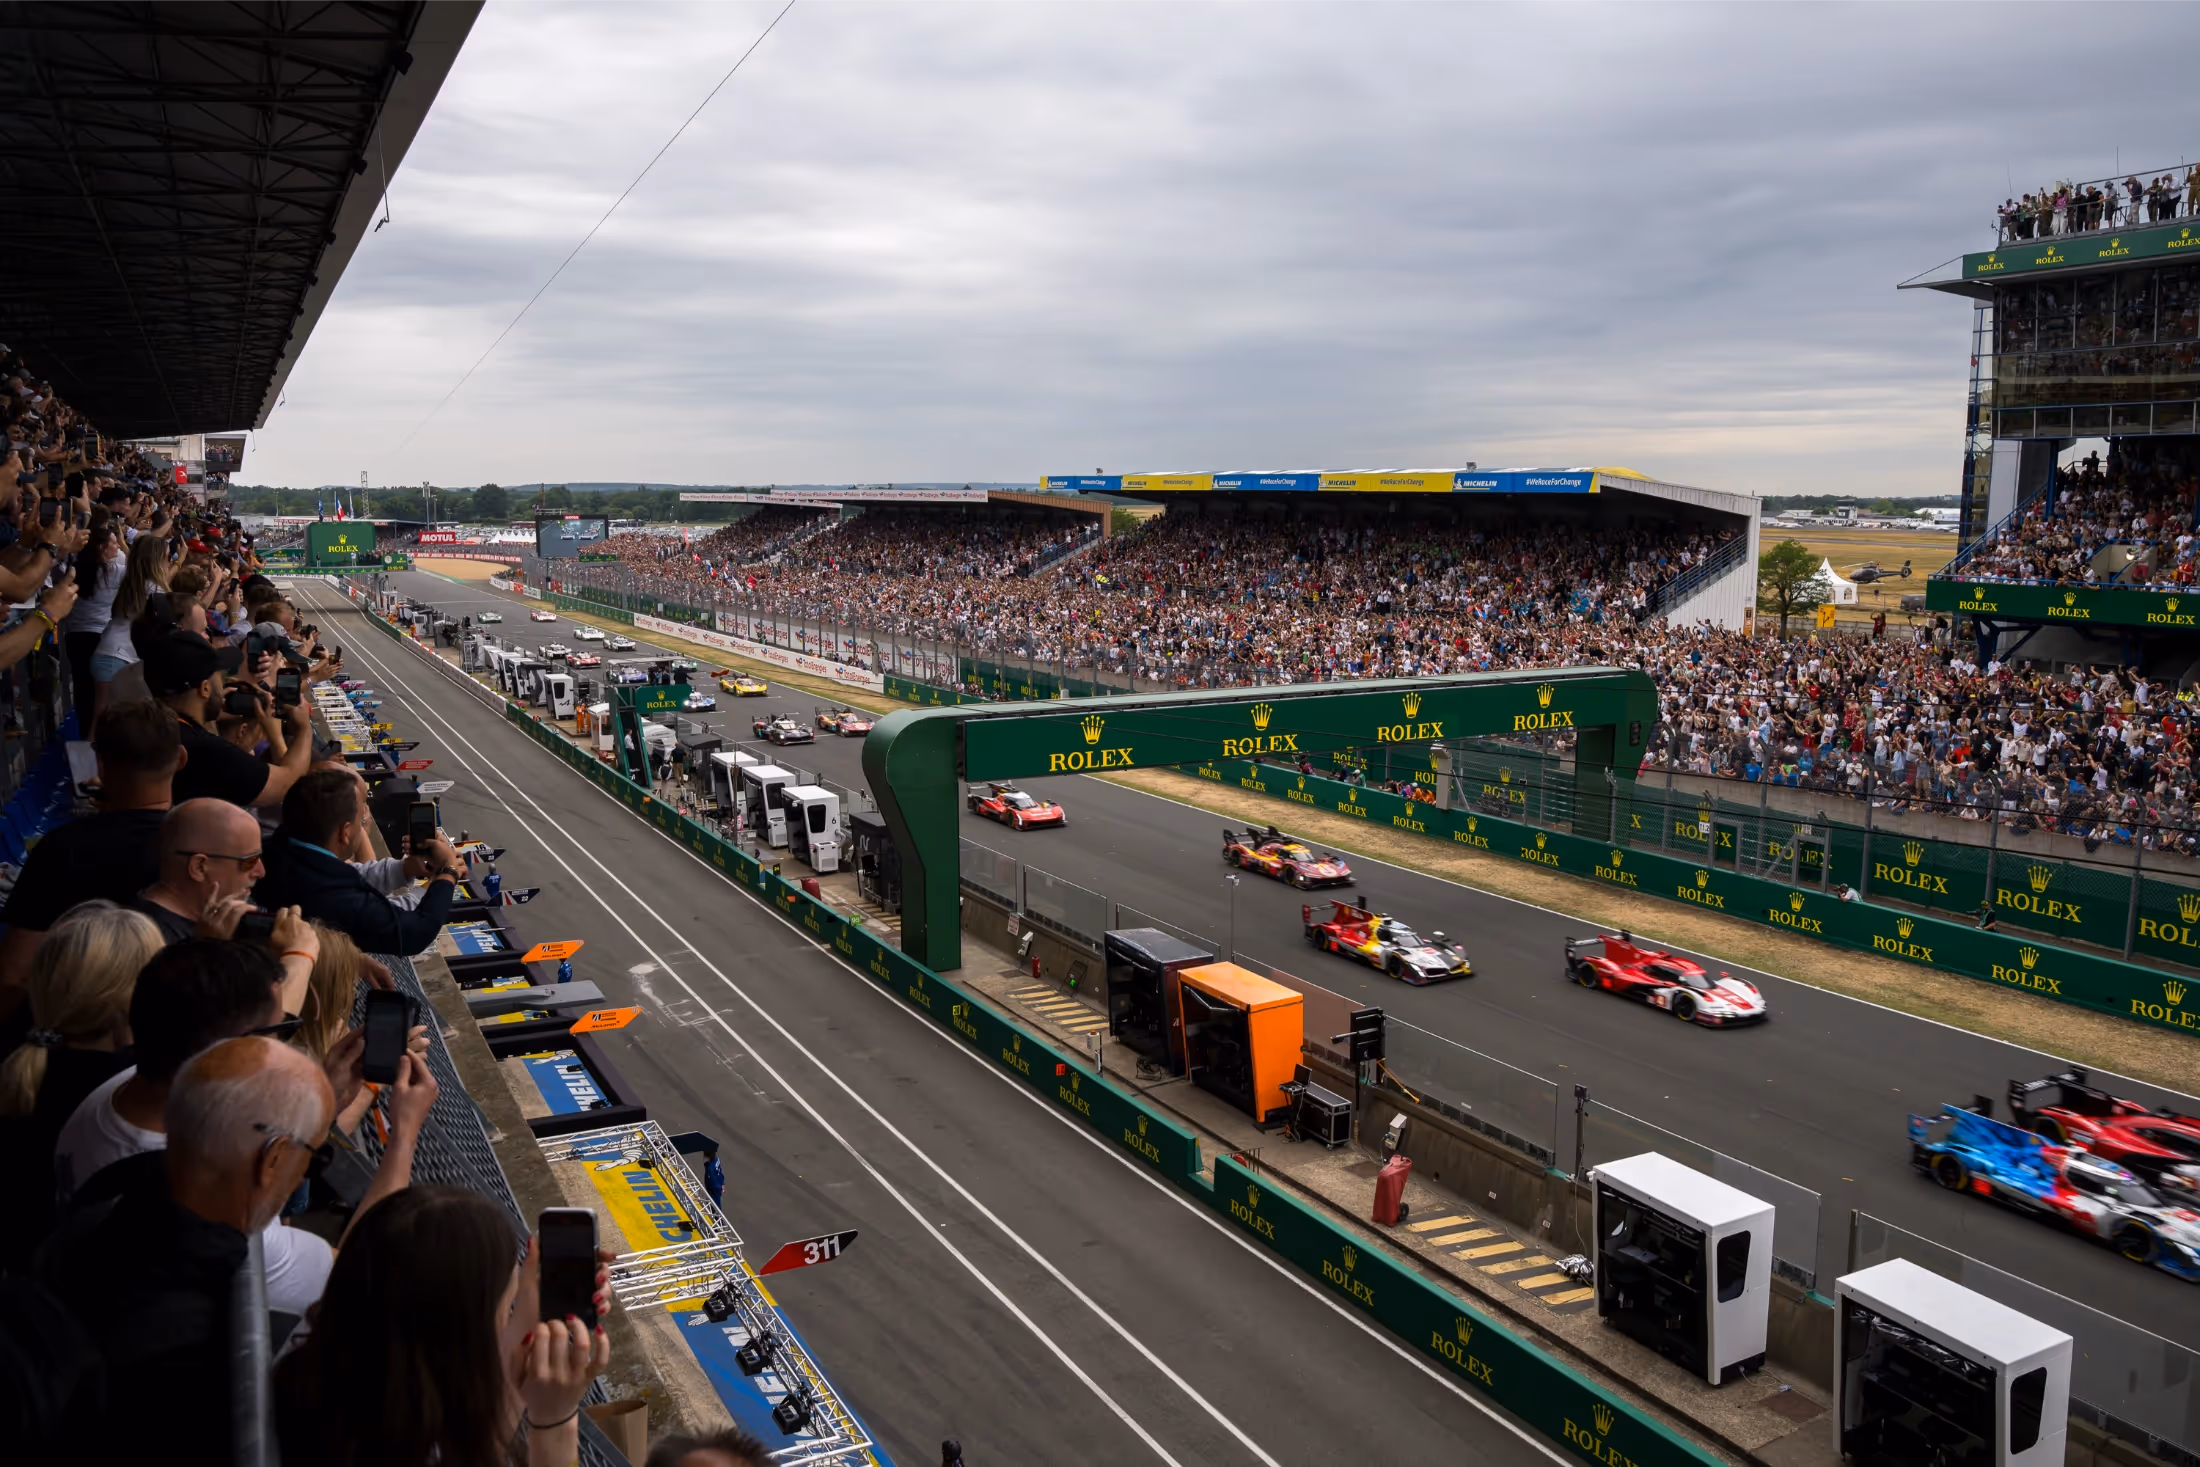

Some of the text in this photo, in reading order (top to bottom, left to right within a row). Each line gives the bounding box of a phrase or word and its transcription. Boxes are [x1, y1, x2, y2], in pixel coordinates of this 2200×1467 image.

[2099, 247, 2129, 257] ROLEX
[2167, 238, 2200, 249] ROLEX
[1977, 262, 2004, 272] ROLEX
[2035, 255, 2065, 265] ROLEX
[1526, 478, 1582, 487] #WeRaceForChange
[421, 533, 454, 542] MOTUL
[1959, 600, 1998, 612] ROLEX
[2047, 606, 2090, 619] ROLEX
[2147, 613, 2195, 625] ROLEX
[647, 701, 677, 709] ROLEX
[1513, 711, 1574, 731] ROLEX
[1377, 722, 1444, 743] ROLEX
[1222, 734, 1298, 757] ROLEX
[1049, 748, 1134, 772] ROLEX
[1199, 767, 1221, 780] ROLEX
[1241, 778, 1265, 792] ROLEX
[1483, 784, 1526, 804] ROEX
[1288, 789, 1315, 804] ROLEX
[1338, 801, 1367, 817] ROLEX
[1393, 816, 1425, 832] ROLEX
[1454, 831, 1488, 848] ROLEX
[1595, 865, 1638, 886] ROLEX
[1874, 863, 1949, 894] ROLEX
[1677, 886, 1725, 909] ROLEX
[1996, 888, 2082, 923] ROLEX
[1769, 909, 1823, 934] ROLEX
[1873, 935, 1933, 962] ROLEX
[870, 959, 890, 980] ROLEX
[1992, 965, 2062, 994] ROLEX
[909, 985, 930, 1008] ROLEX
[953, 1015, 977, 1040] ROLEX
[1002, 1047, 1030, 1076] ROLEX
[1059, 1085, 1091, 1117] ROLEX
[1124, 1126, 1160, 1163] ROLEX
[1230, 1197, 1275, 1241] ROLEX
[803, 1236, 842, 1265] 311
[1322, 1258, 1375, 1308] ROLEX
[1431, 1330, 1494, 1387] ROLEX
